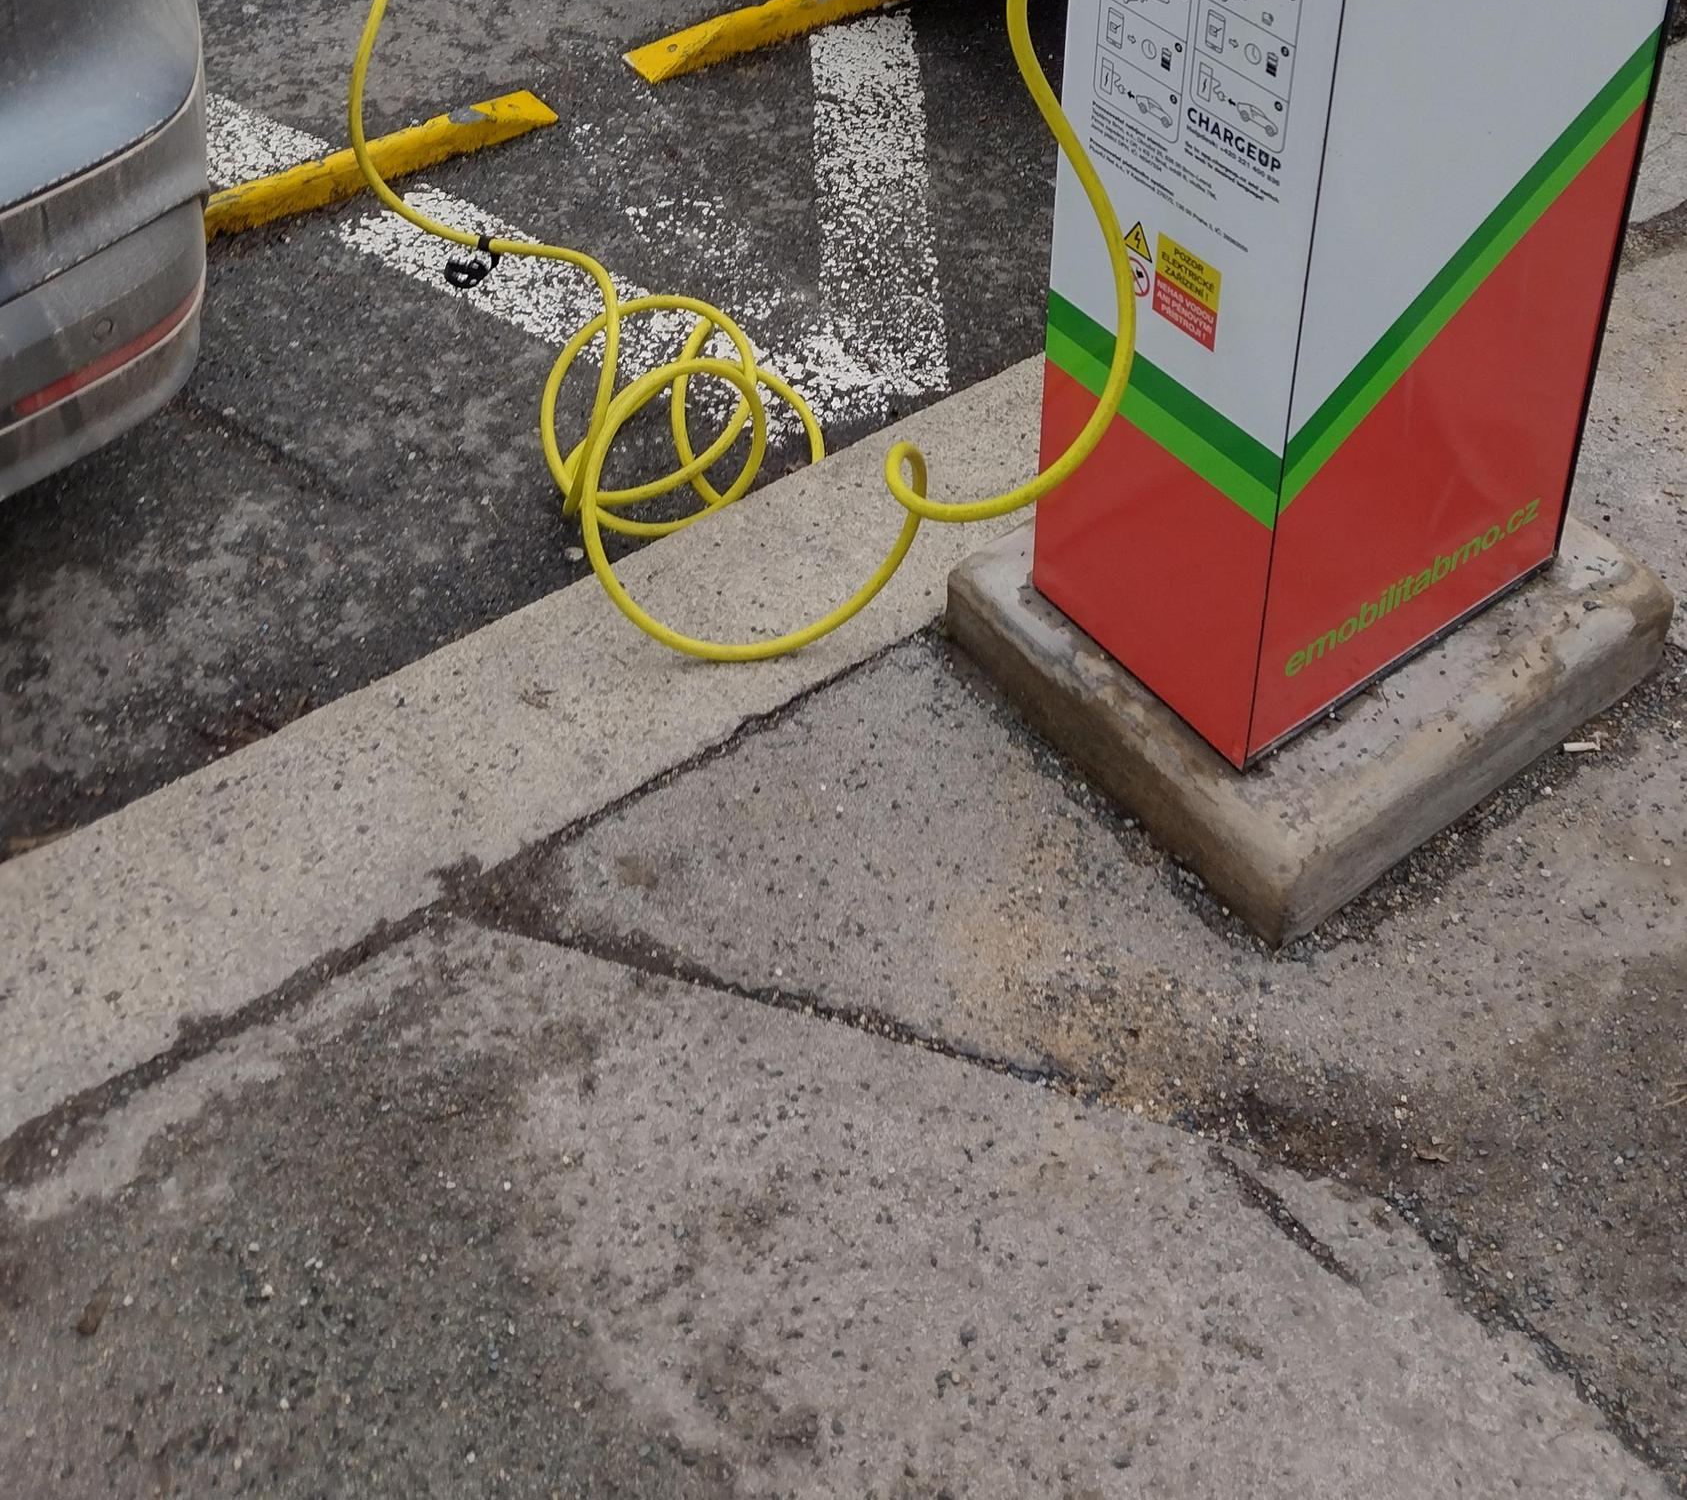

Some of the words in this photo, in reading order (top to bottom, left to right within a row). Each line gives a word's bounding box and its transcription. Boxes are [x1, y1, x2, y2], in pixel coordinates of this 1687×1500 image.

[1187, 107, 1281, 172] CHARGEUP
[1174, 247, 1204, 275] POZOR
[1284, 497, 1542, 678] emobilitabrno.cz
